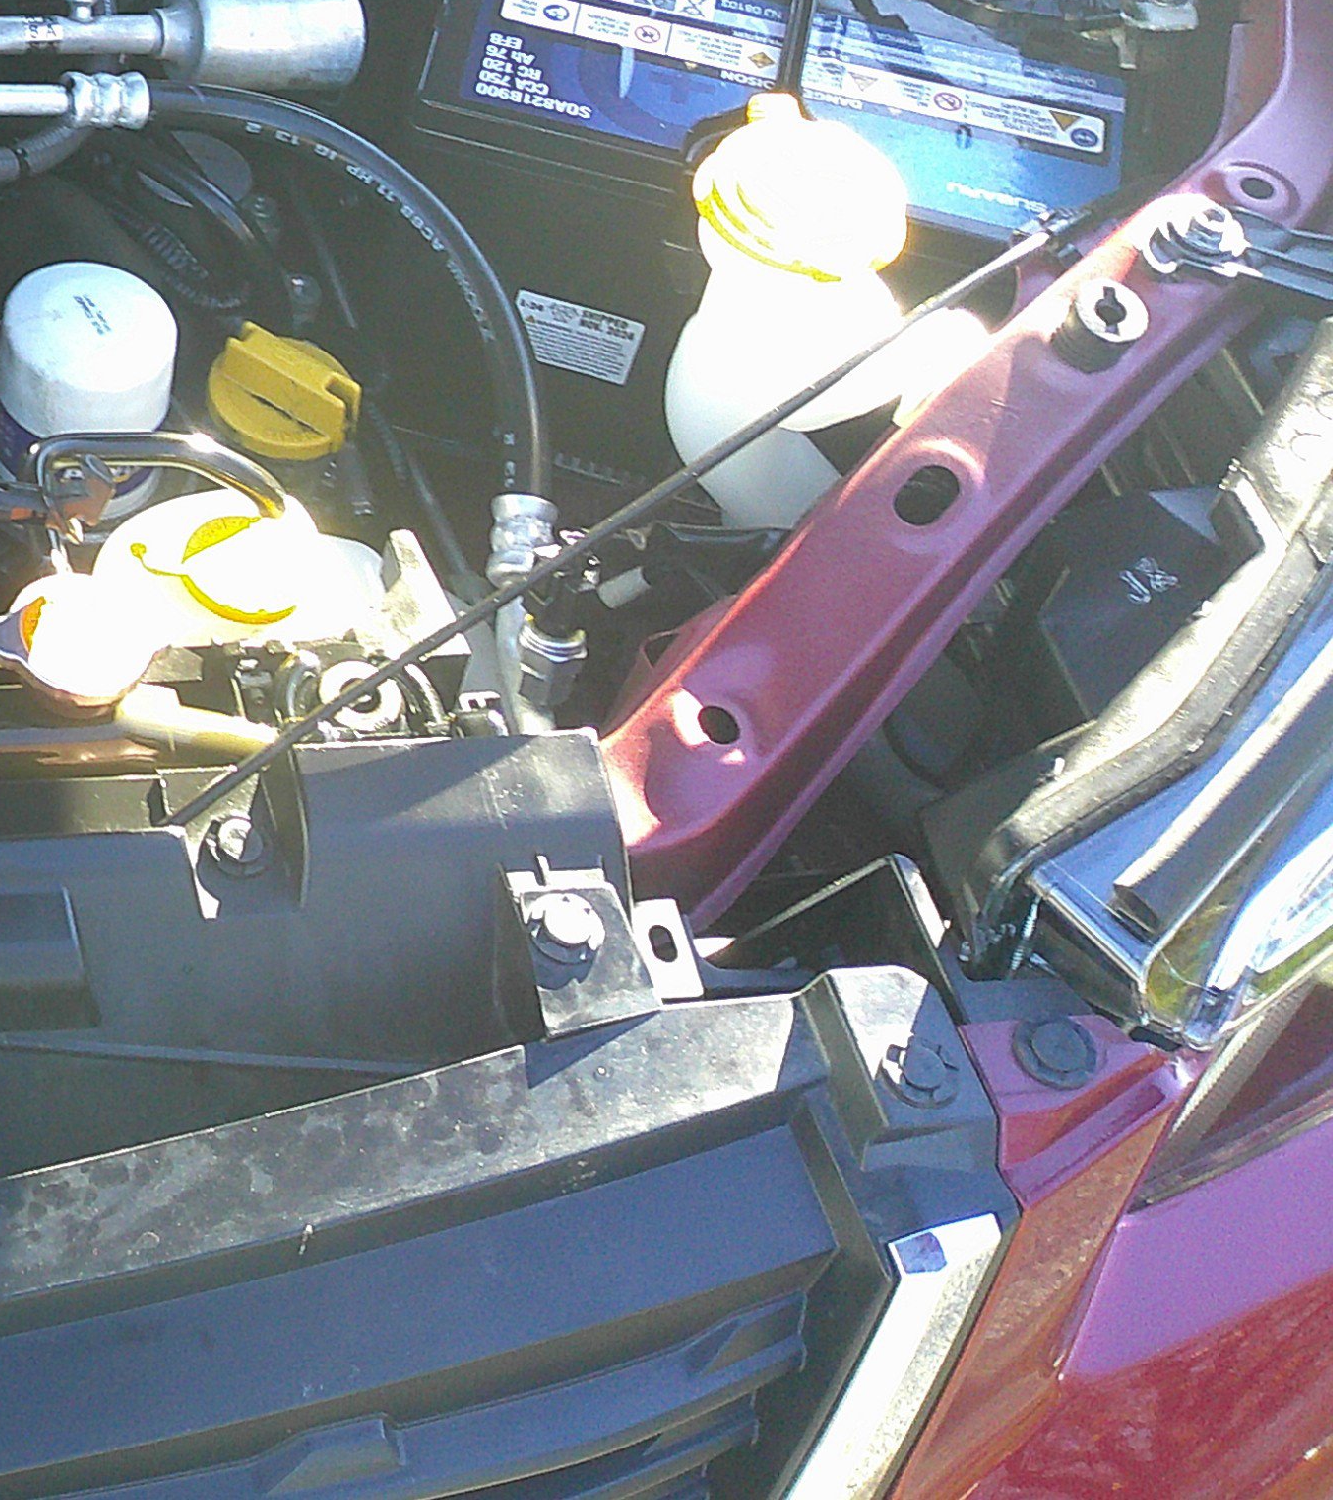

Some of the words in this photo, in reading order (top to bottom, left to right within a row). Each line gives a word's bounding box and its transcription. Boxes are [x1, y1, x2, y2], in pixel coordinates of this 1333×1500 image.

[488, 32, 523, 50] EFB
[485, 44, 507, 60] 76
[510, 50, 535, 66] Ah
[482, 57, 513, 73] 120
[516, 65, 542, 81] RC
[478, 69, 511, 87] 750
[514, 77, 550, 95] CCA
